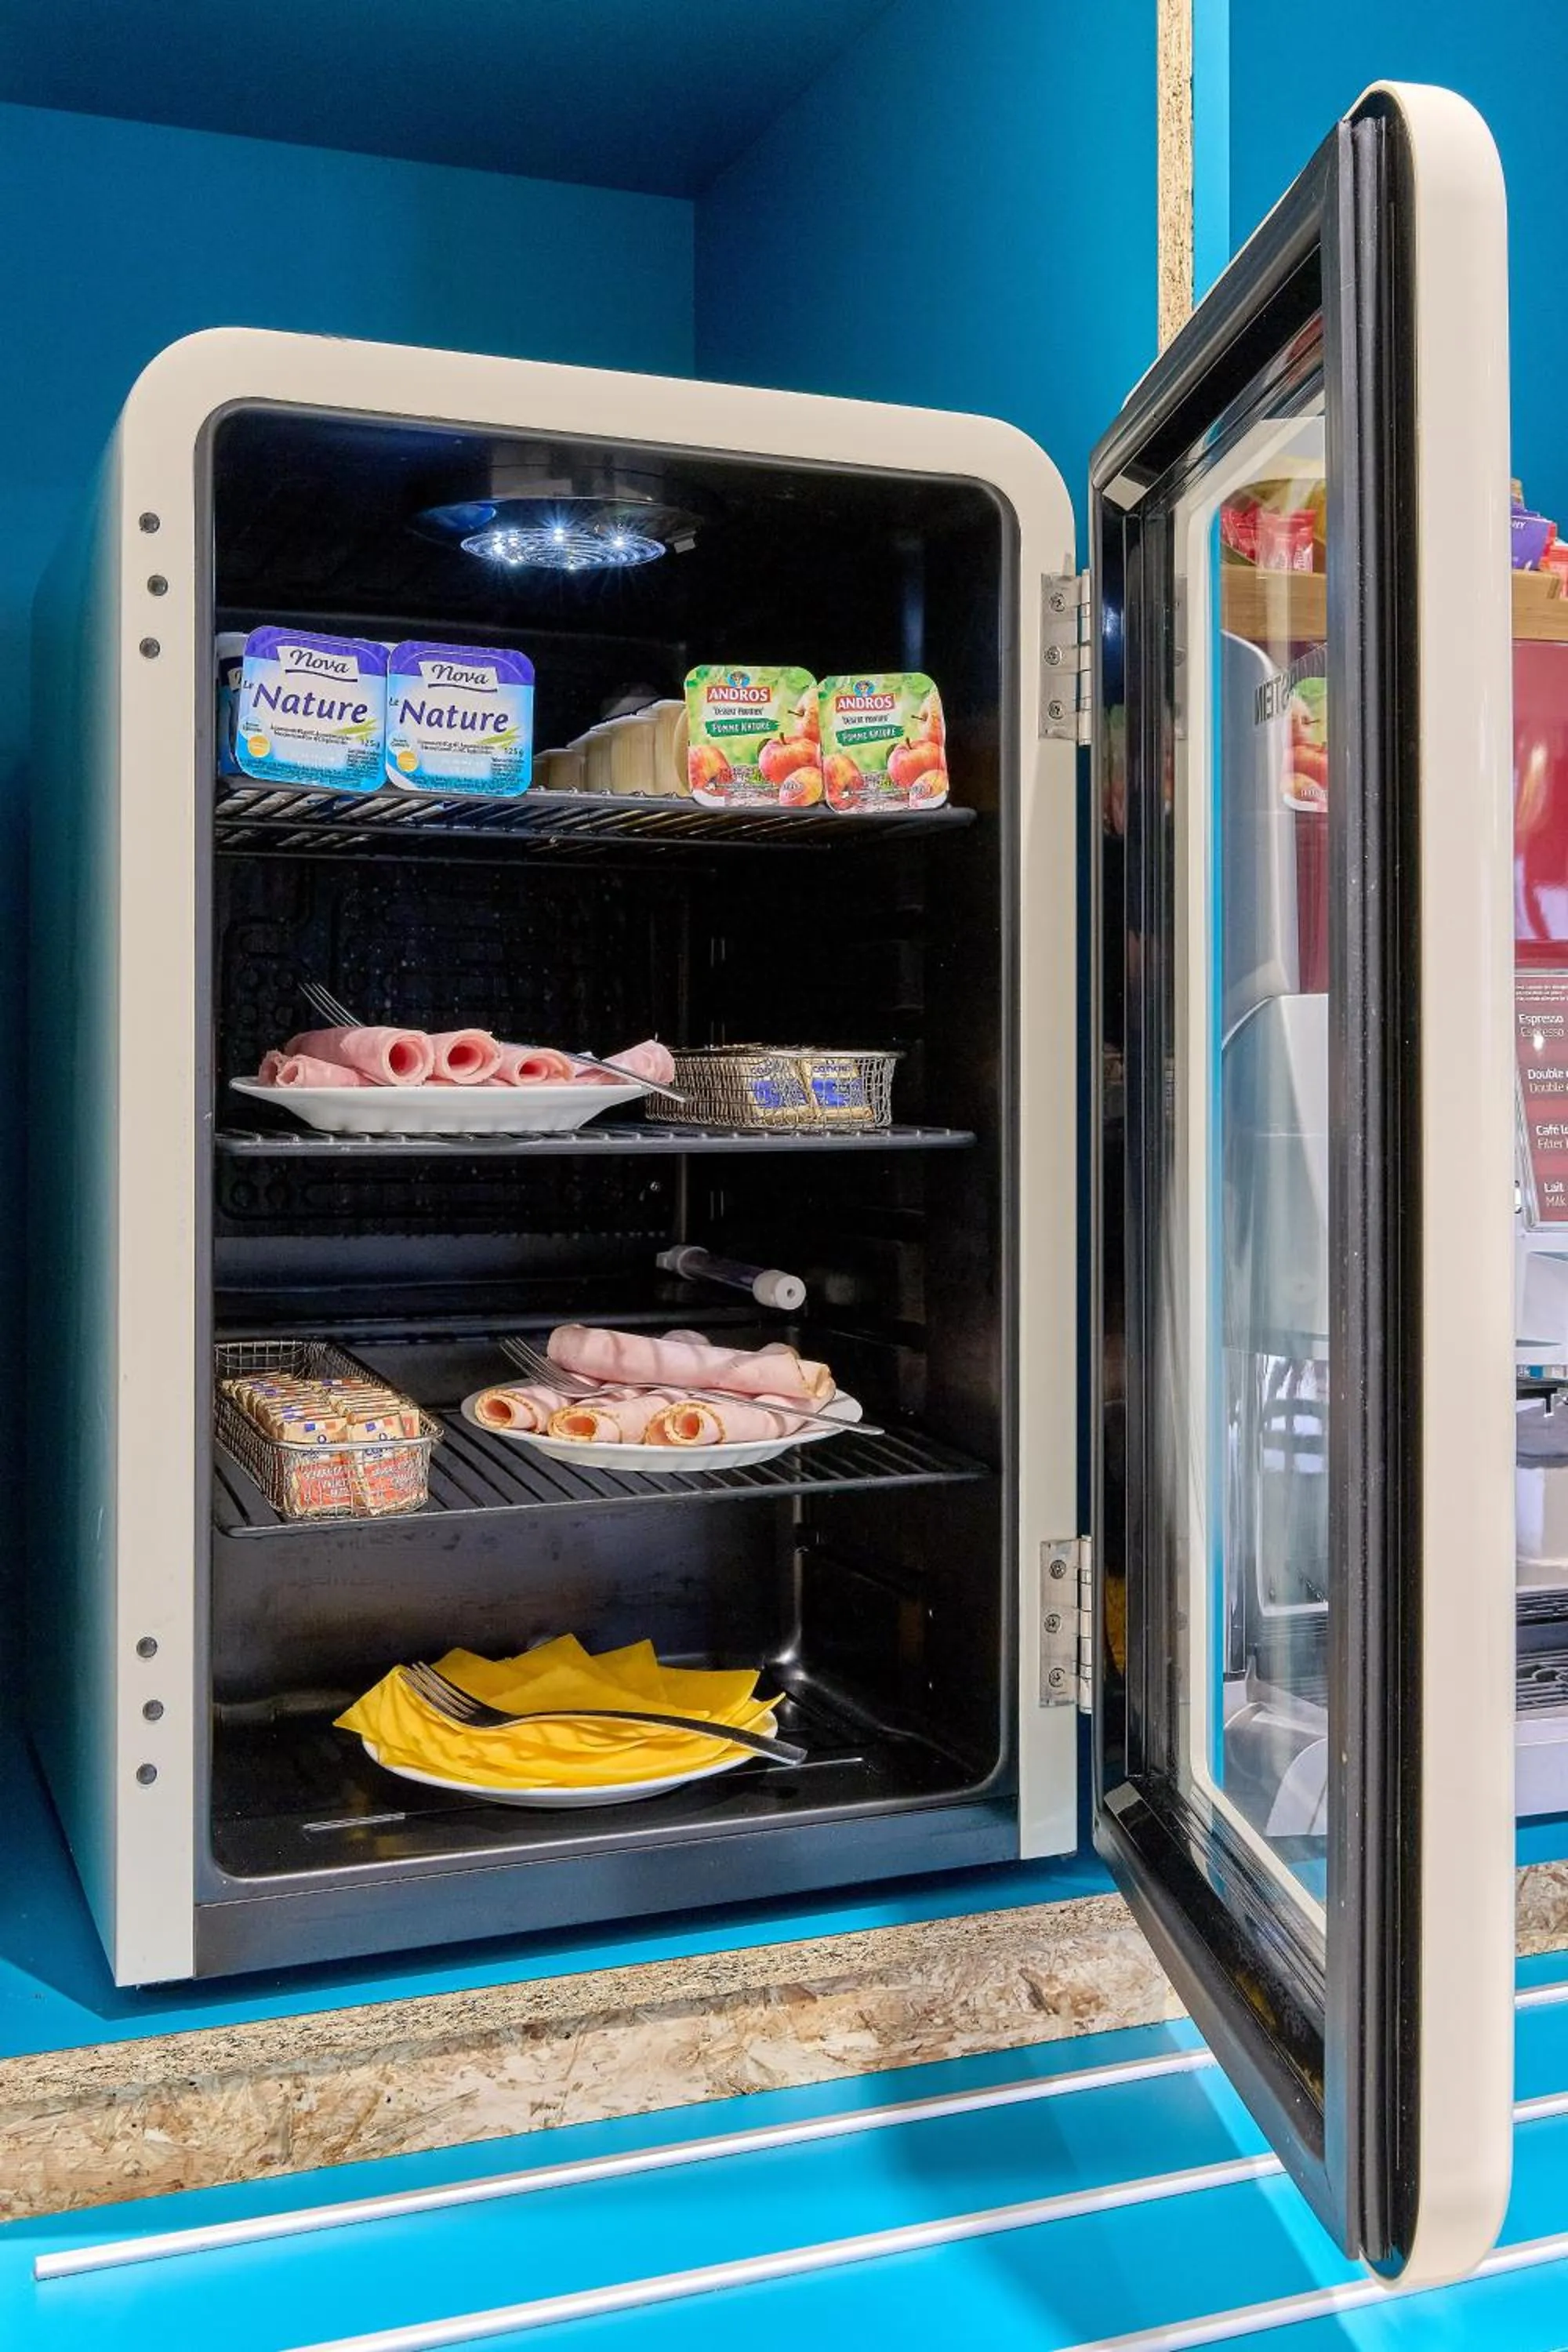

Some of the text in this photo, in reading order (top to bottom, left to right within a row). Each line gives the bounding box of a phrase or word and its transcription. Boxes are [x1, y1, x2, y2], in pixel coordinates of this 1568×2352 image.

[289, 648, 350, 673] Nova
[431, 663, 489, 684] Nova
[708, 688, 768, 701] ANDROS
[252, 683, 368, 723] Nature
[837, 695, 892, 710] ANDROS
[399, 698, 509, 733] Nature
[1519, 1014, 1564, 1025] Espresso
[1527, 1068, 1564, 1080] Double
[1530, 1083, 1564, 1094] Double
[1537, 1123, 1559, 1136] Café
[1537, 1138, 1563, 1149] Filter
[1544, 1180, 1565, 1192] Lait
[1545, 1195, 1567, 1207] Milk
